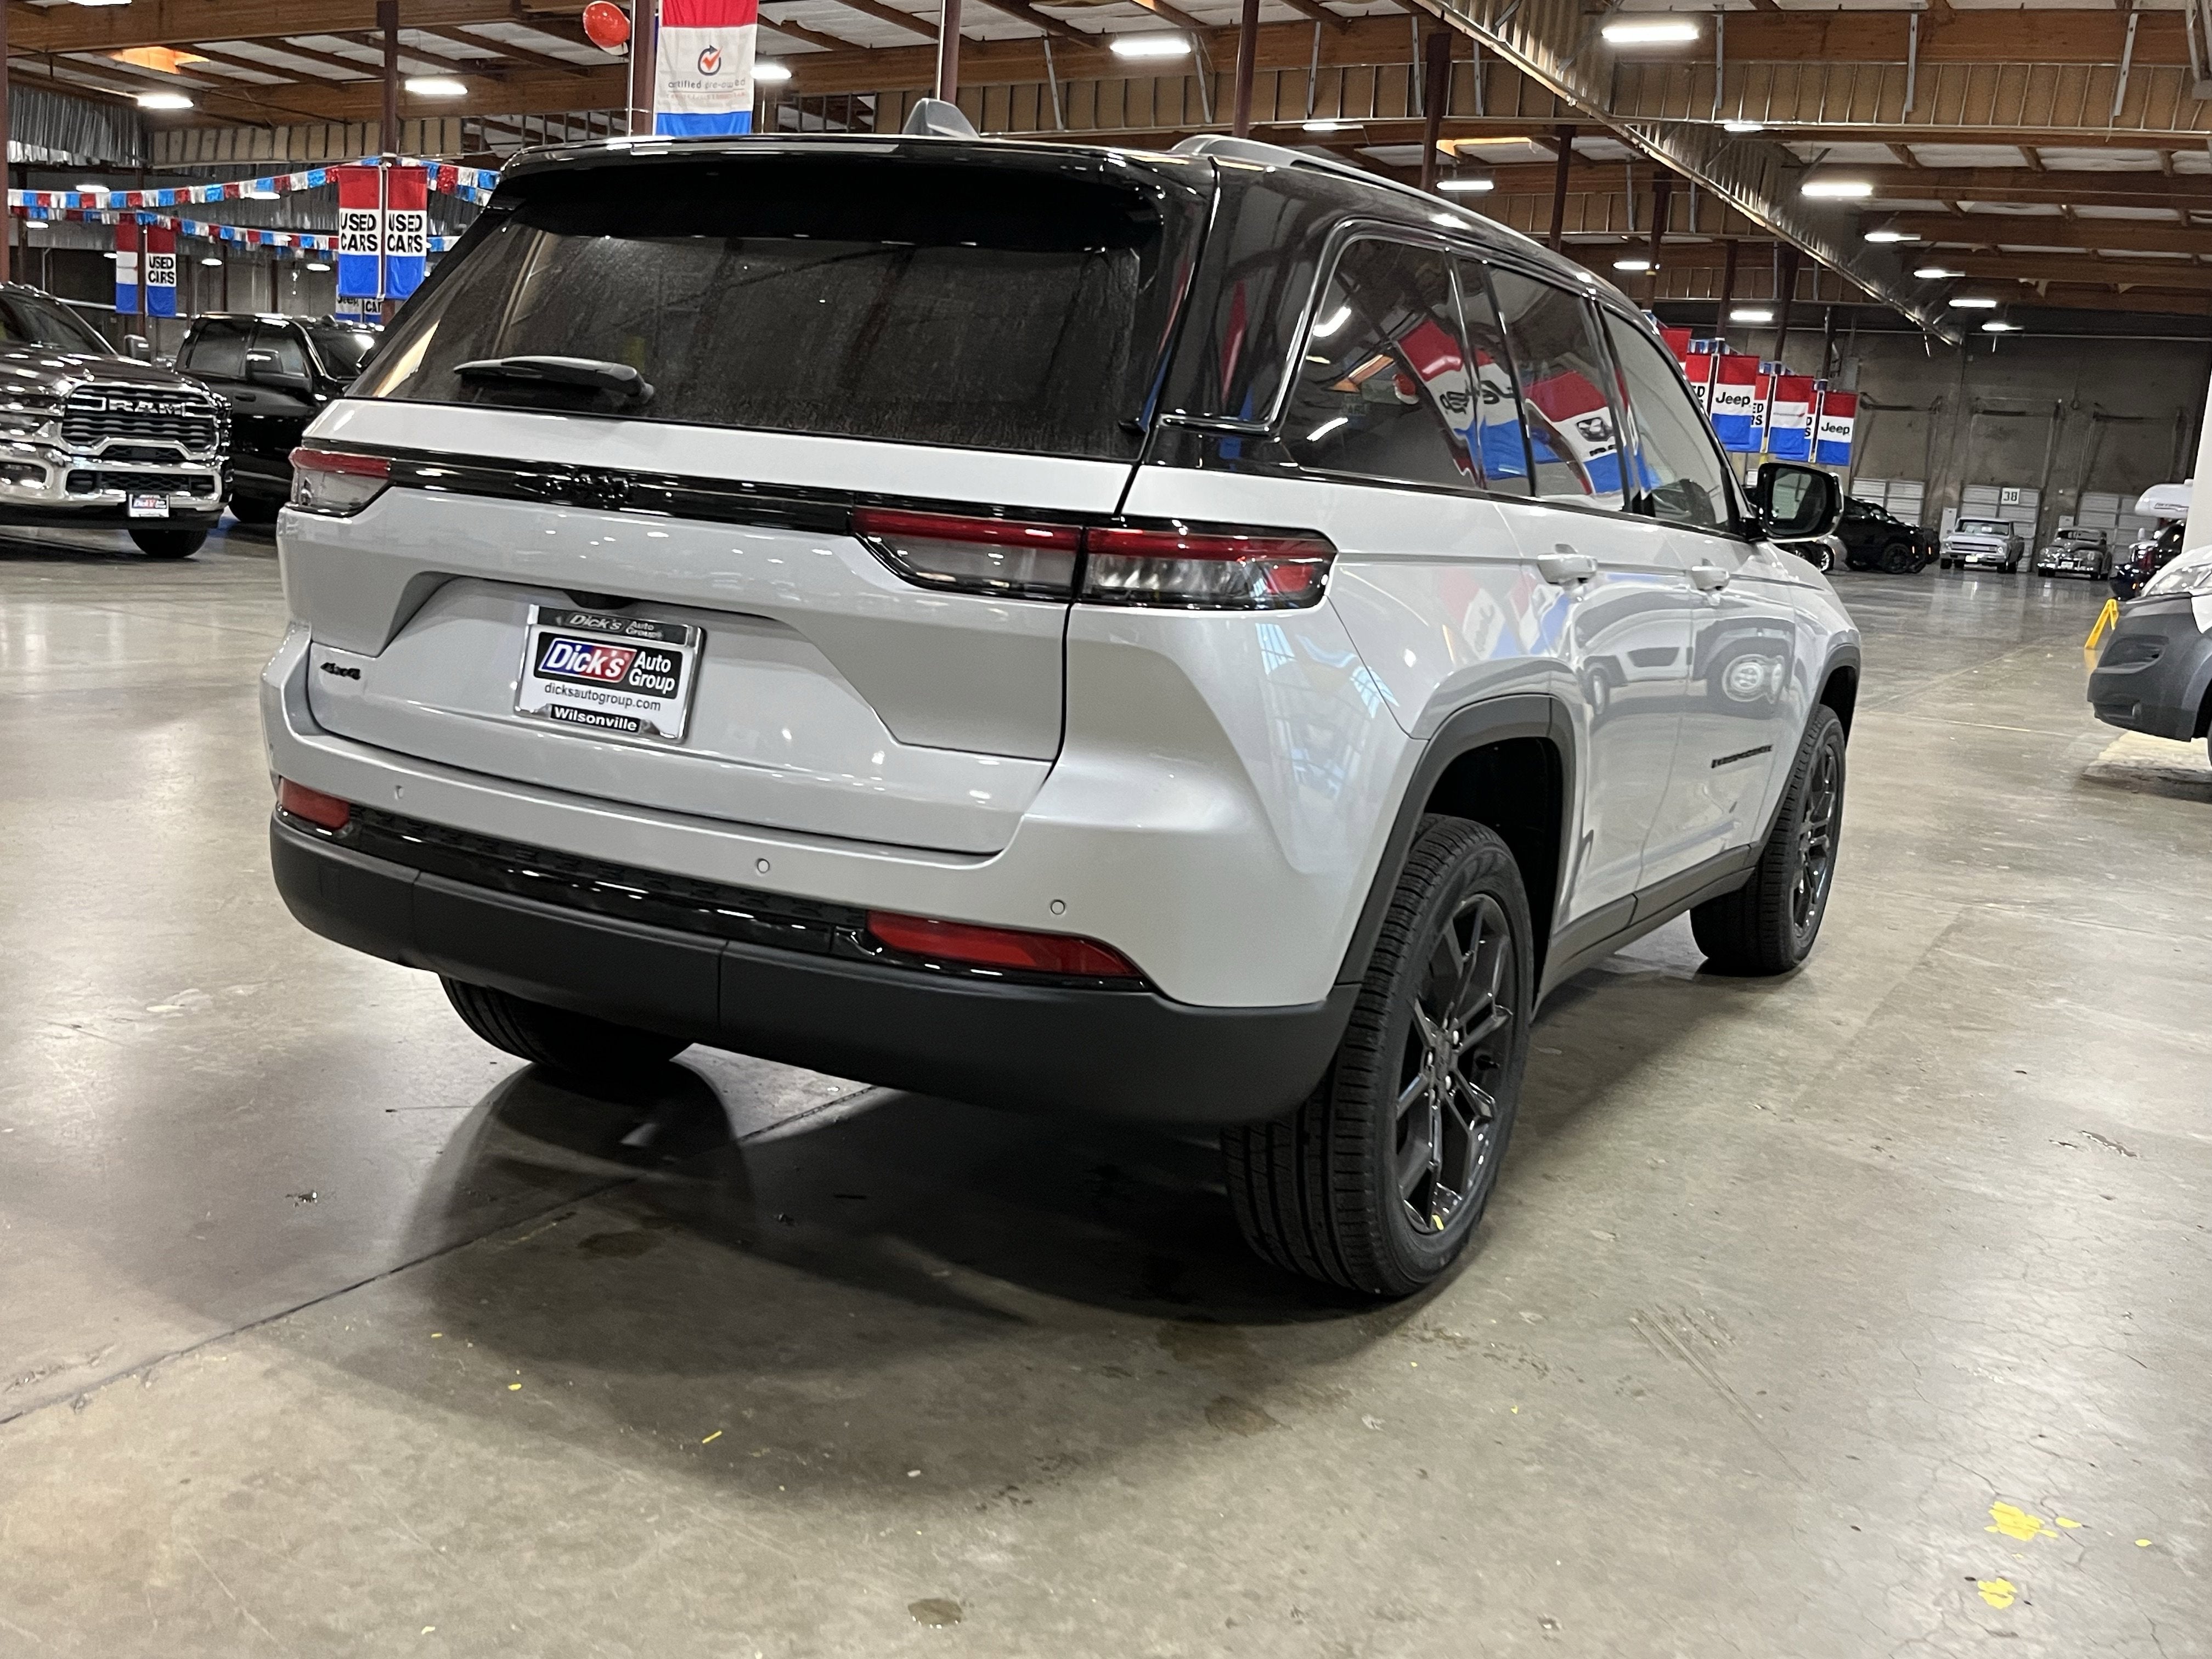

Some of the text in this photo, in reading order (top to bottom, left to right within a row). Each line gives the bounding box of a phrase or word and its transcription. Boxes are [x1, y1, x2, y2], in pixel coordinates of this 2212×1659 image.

[341, 213, 377, 231] USED
[388, 213, 422, 232] USED
[341, 233, 378, 252] CARS
[387, 234, 423, 253] CARS
[149, 255, 174, 269] USED
[109, 399, 182, 415] RAM
[1716, 392, 1751, 407] Jeep
[1821, 422, 1850, 436] Jeep
[2004, 491, 2018, 501] 38
[569, 614, 654, 631] Dick's Auto
[546, 643, 671, 678] Dick's Auto
[628, 668, 675, 695] Group
[544, 682, 661, 712] dicksautogroup.com
[554, 706, 637, 731] Wilsonville
